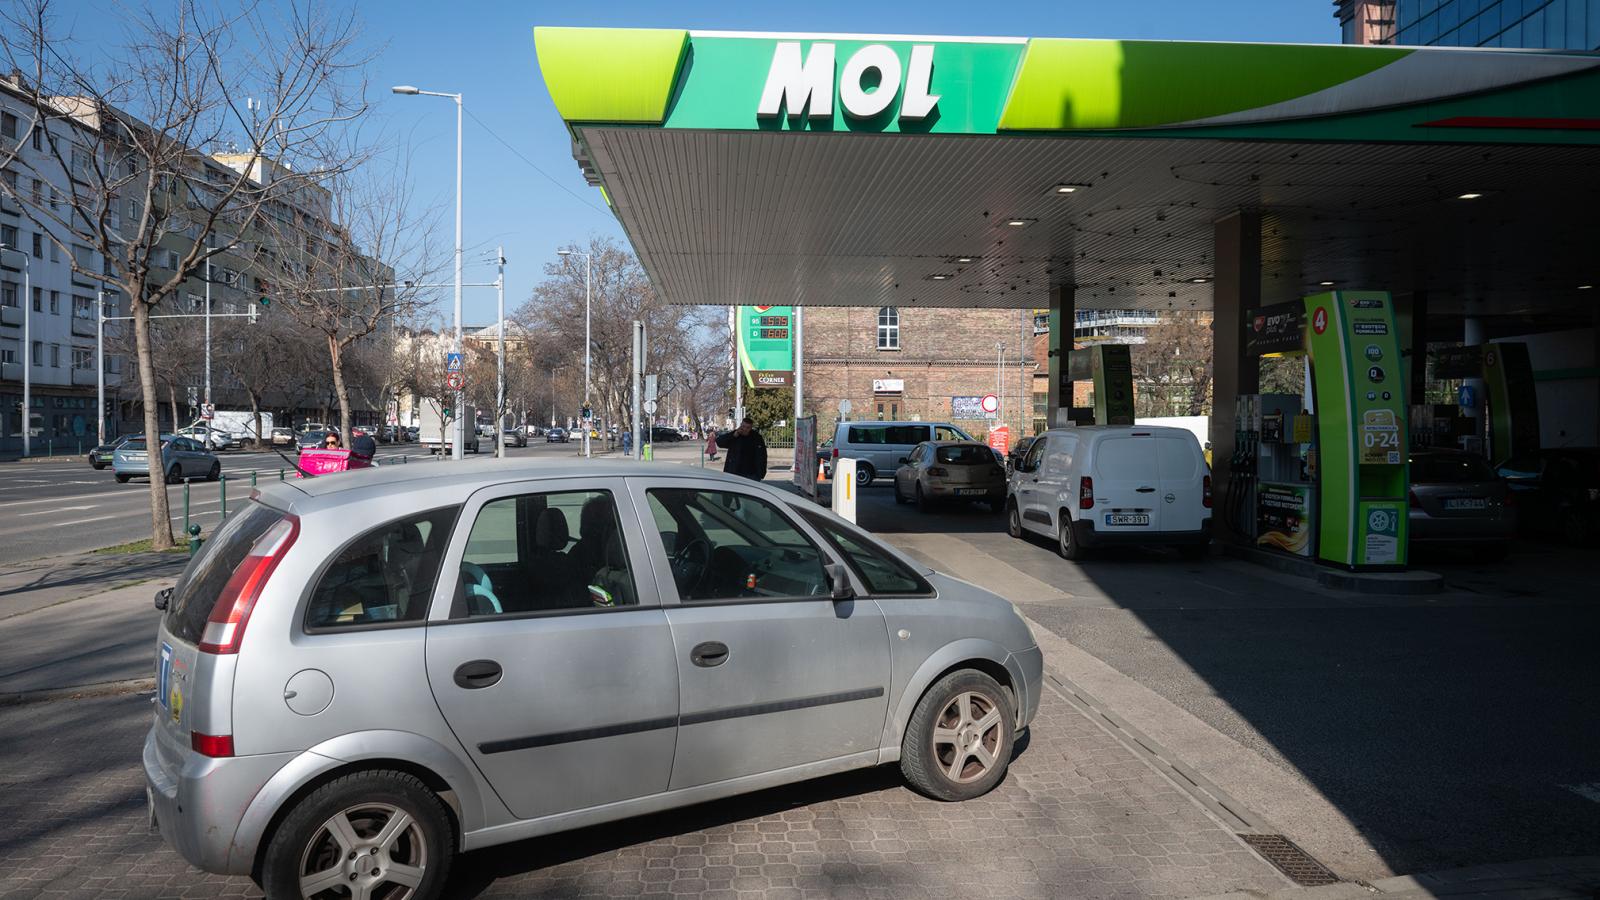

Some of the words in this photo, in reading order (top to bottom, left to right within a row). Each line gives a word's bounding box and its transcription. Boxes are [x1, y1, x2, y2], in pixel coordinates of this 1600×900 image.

[757, 42, 941, 120] MOL
[1314, 311, 1326, 331] 4
[1487, 352, 1495, 366] 6
[1364, 432, 1400, 447] 0-24
[1112, 515, 1148, 524] SWR-391
